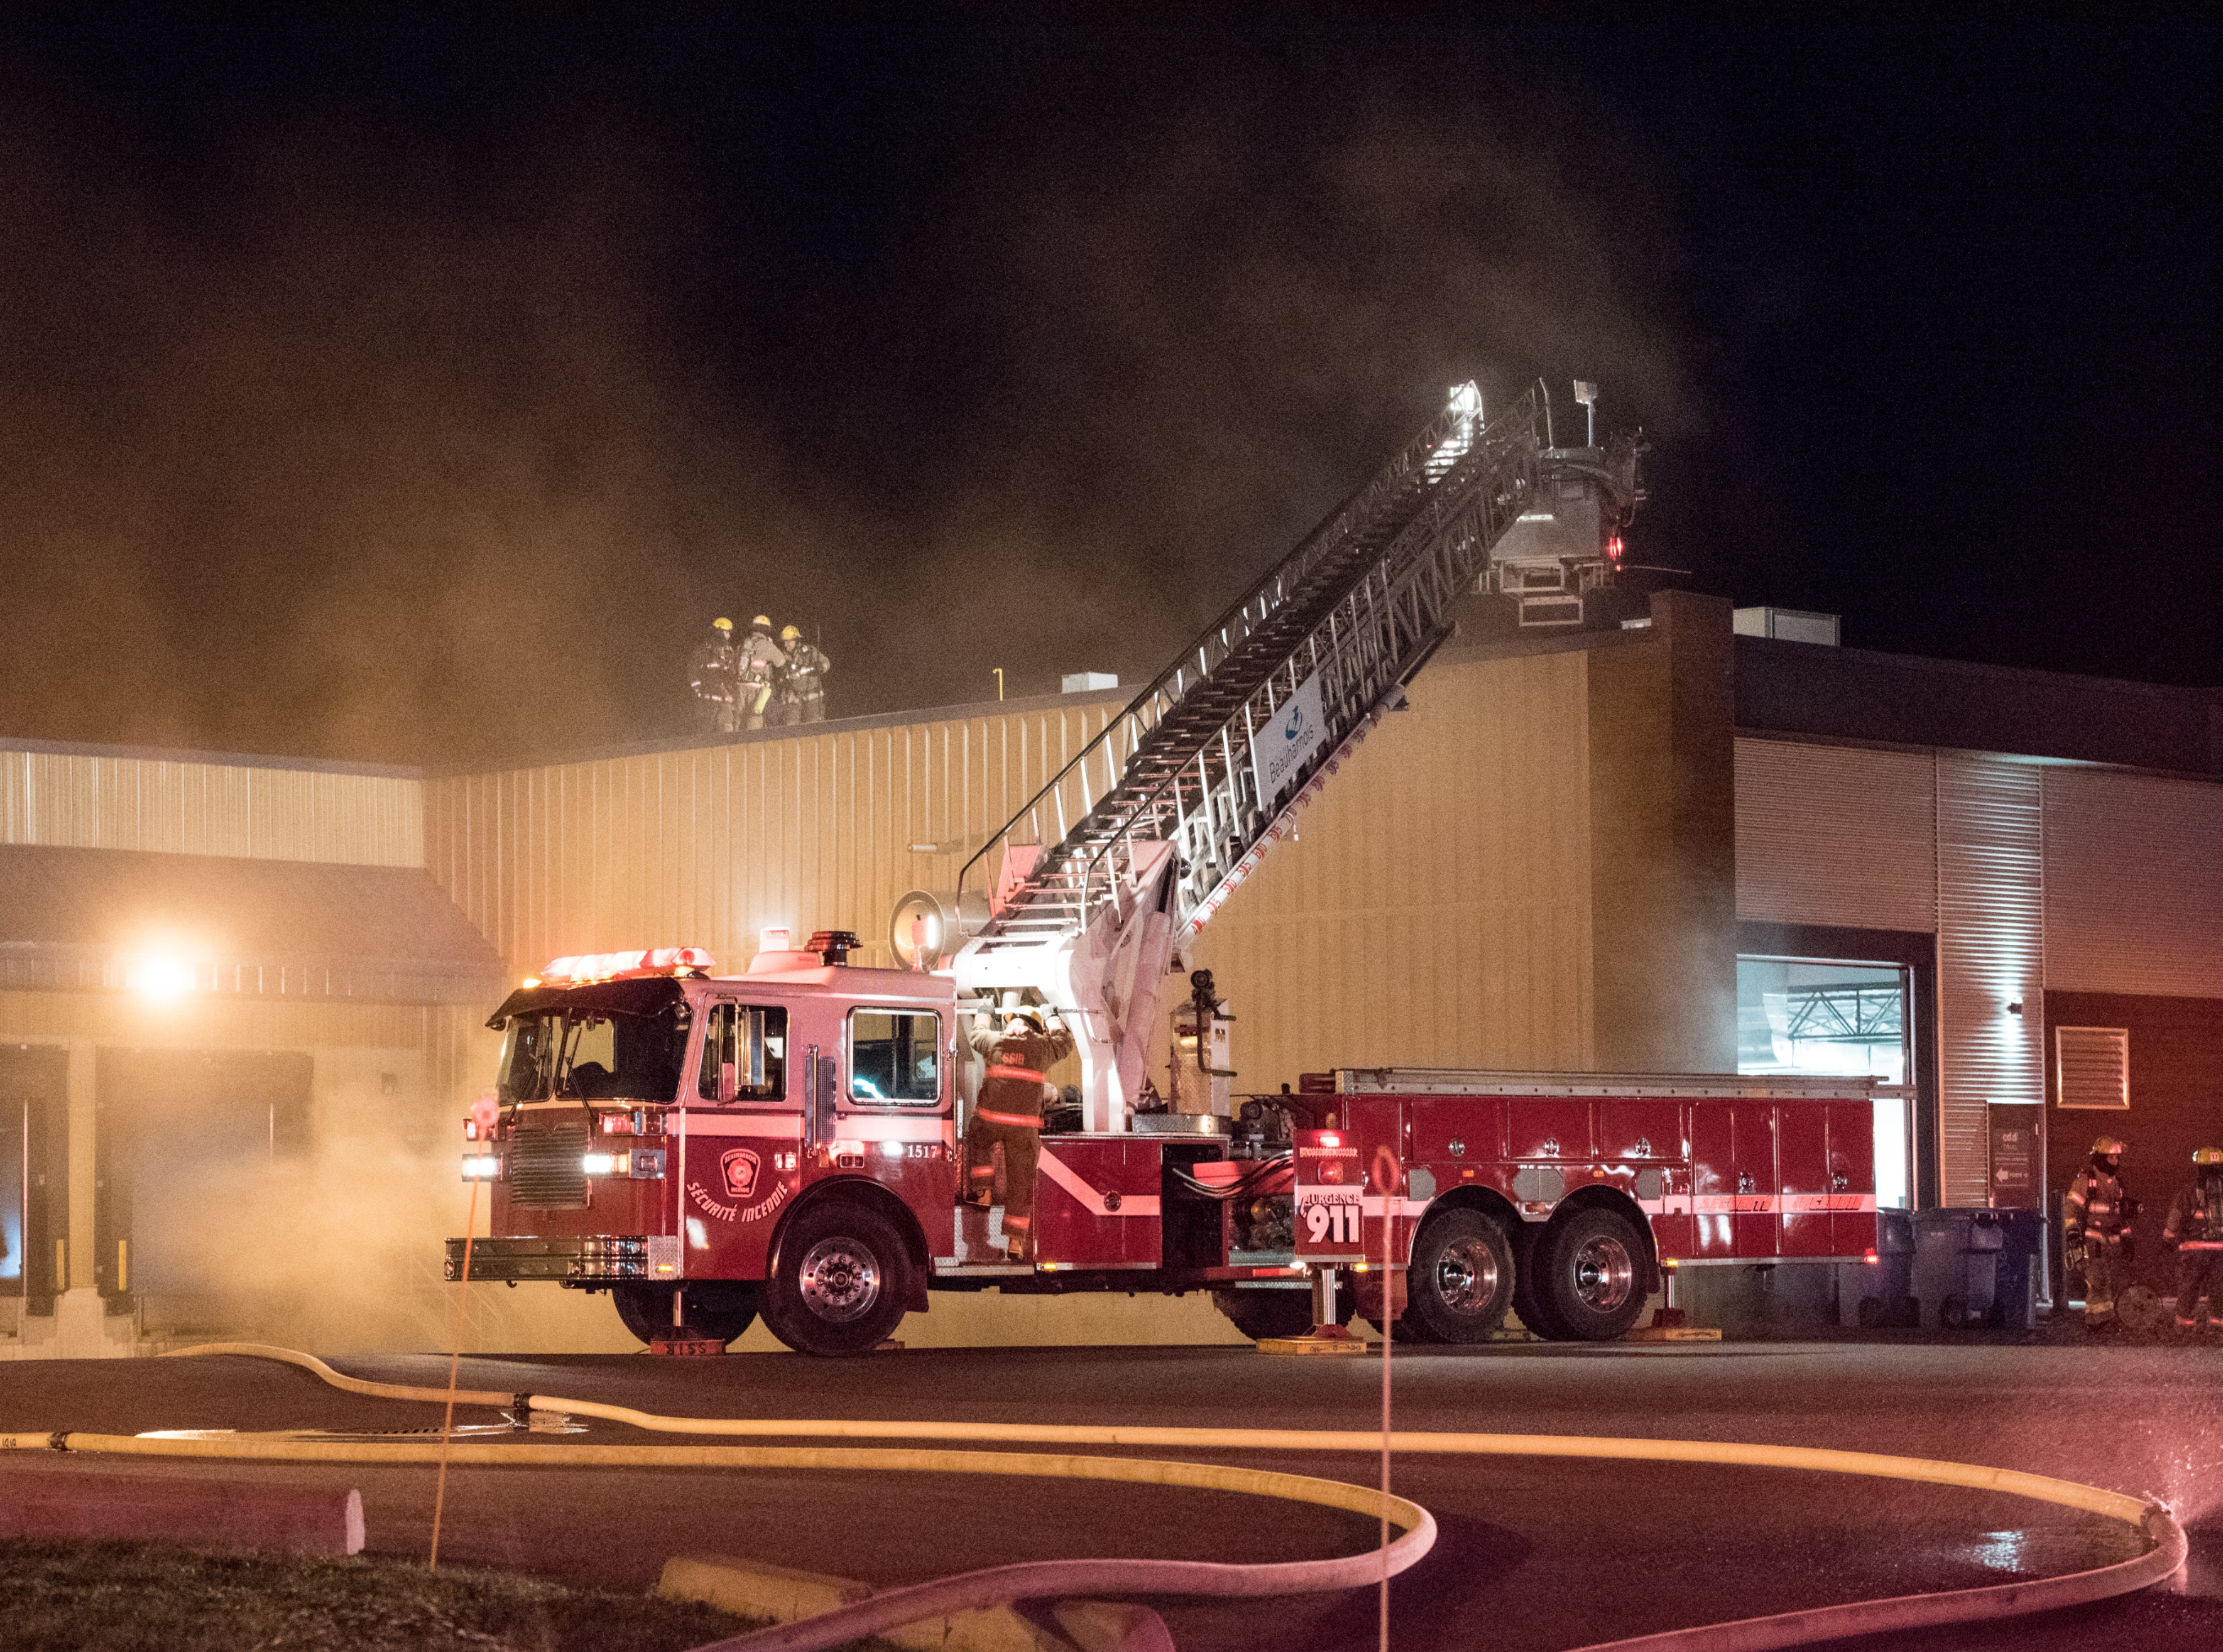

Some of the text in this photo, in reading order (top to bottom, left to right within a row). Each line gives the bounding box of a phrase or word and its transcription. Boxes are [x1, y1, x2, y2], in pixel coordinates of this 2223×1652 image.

[1269, 724, 1314, 784] Beauharnois
[724, 1152, 756, 1164] BEAUHARNOIS
[907, 1145, 937, 1158] 1517
[687, 1181, 788, 1222] SÉCURITÉ INCENDIE
[1309, 1193, 1360, 1205] URGENCE
[1306, 1204, 1360, 1243] 911
